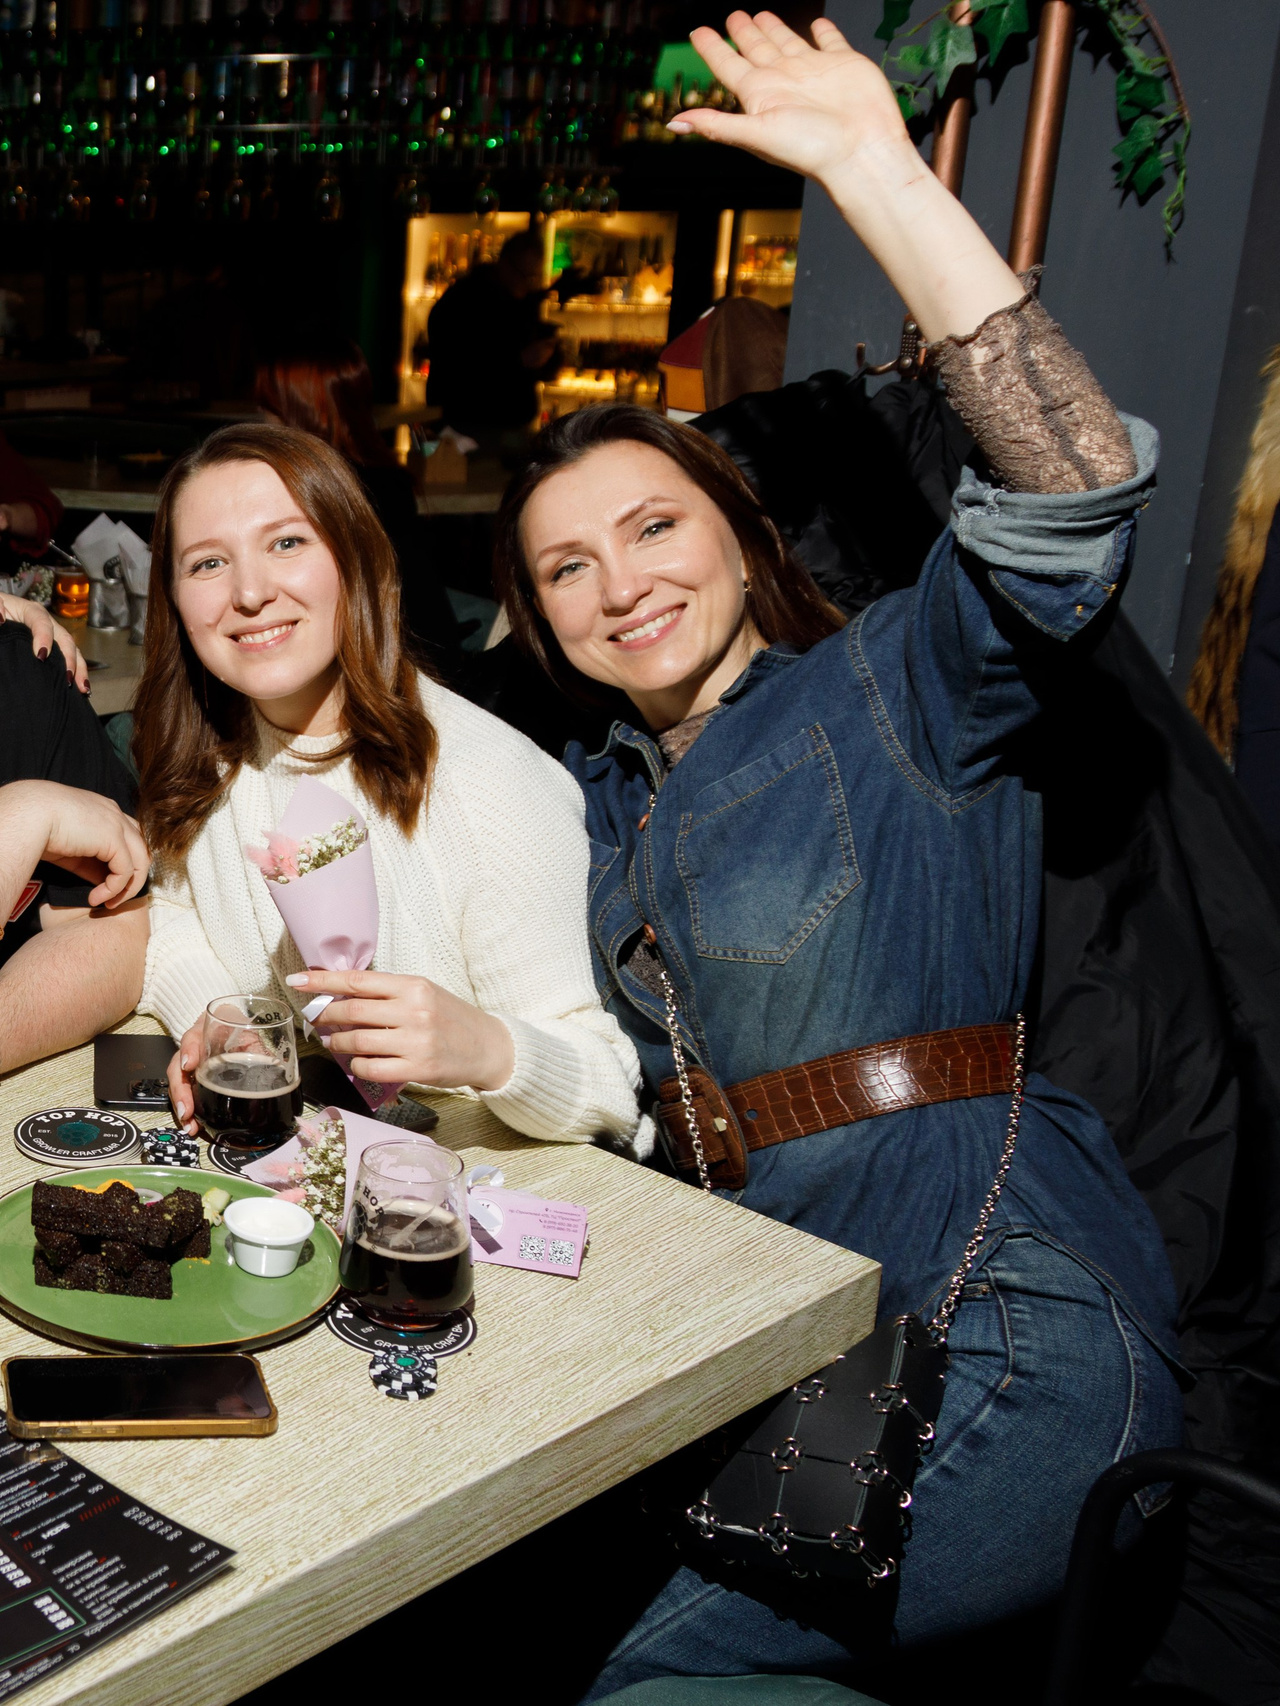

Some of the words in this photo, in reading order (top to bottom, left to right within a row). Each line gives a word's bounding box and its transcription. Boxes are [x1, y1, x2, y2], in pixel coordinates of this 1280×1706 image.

[35, 1111, 76, 1123] TOP
[84, 1111, 125, 1127] HOP
[32, 1137, 70, 1156] GROWLER
[72, 1148, 103, 1157] CRAFT
[102, 1142, 120, 1153] BAR
[363, 1185, 385, 1216] HOP
[433, 1332, 460, 1350] CRAFT
